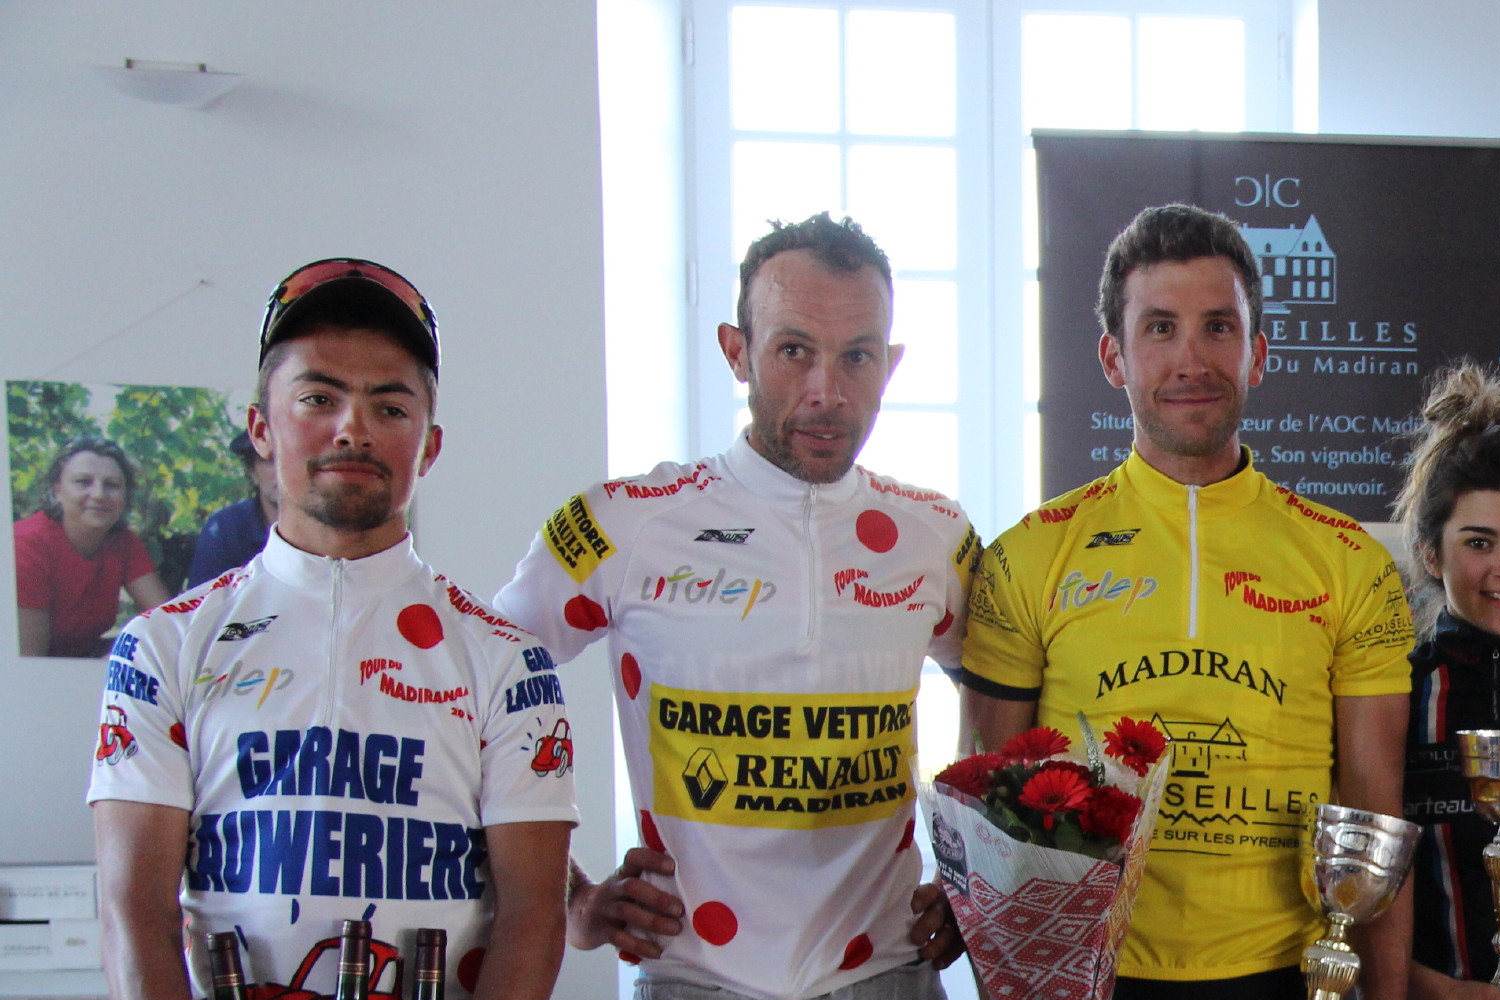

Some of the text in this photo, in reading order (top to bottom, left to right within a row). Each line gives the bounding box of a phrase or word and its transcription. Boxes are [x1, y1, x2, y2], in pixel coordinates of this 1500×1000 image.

[1271, 320, 1418, 343] EILLES
[1265, 355, 1418, 375] Du Madiran
[1279, 414, 1300, 432] de
[1309, 415, 1366, 433] l'AOC
[1372, 415, 1424, 434] Madi
[1091, 446, 1109, 461] et
[1271, 448, 1305, 463] Son
[1311, 447, 1395, 468] vignoble,
[1296, 476, 1386, 495] émouvoir.
[931, 504, 958, 519] 2017
[1336, 531, 1361, 551] 2017
[834, 568, 855, 596] TOUR
[1224, 570, 1248, 597] TOUR
[1243, 583, 1329, 613] MADIRANAIS
[491, 629, 521, 643] 2017
[360, 658, 402, 686] TOUR DU
[1096, 649, 1287, 706] MADIRAN
[660, 697, 791, 739] GARAGE
[236, 726, 425, 806] GARAGE
[733, 745, 901, 790] RENAULT
[734, 781, 908, 813] MADIRAN
[1163, 829, 1198, 842] SUR
[1203, 832, 1235, 845] LES
[185, 810, 487, 900] LAUWERIERE
